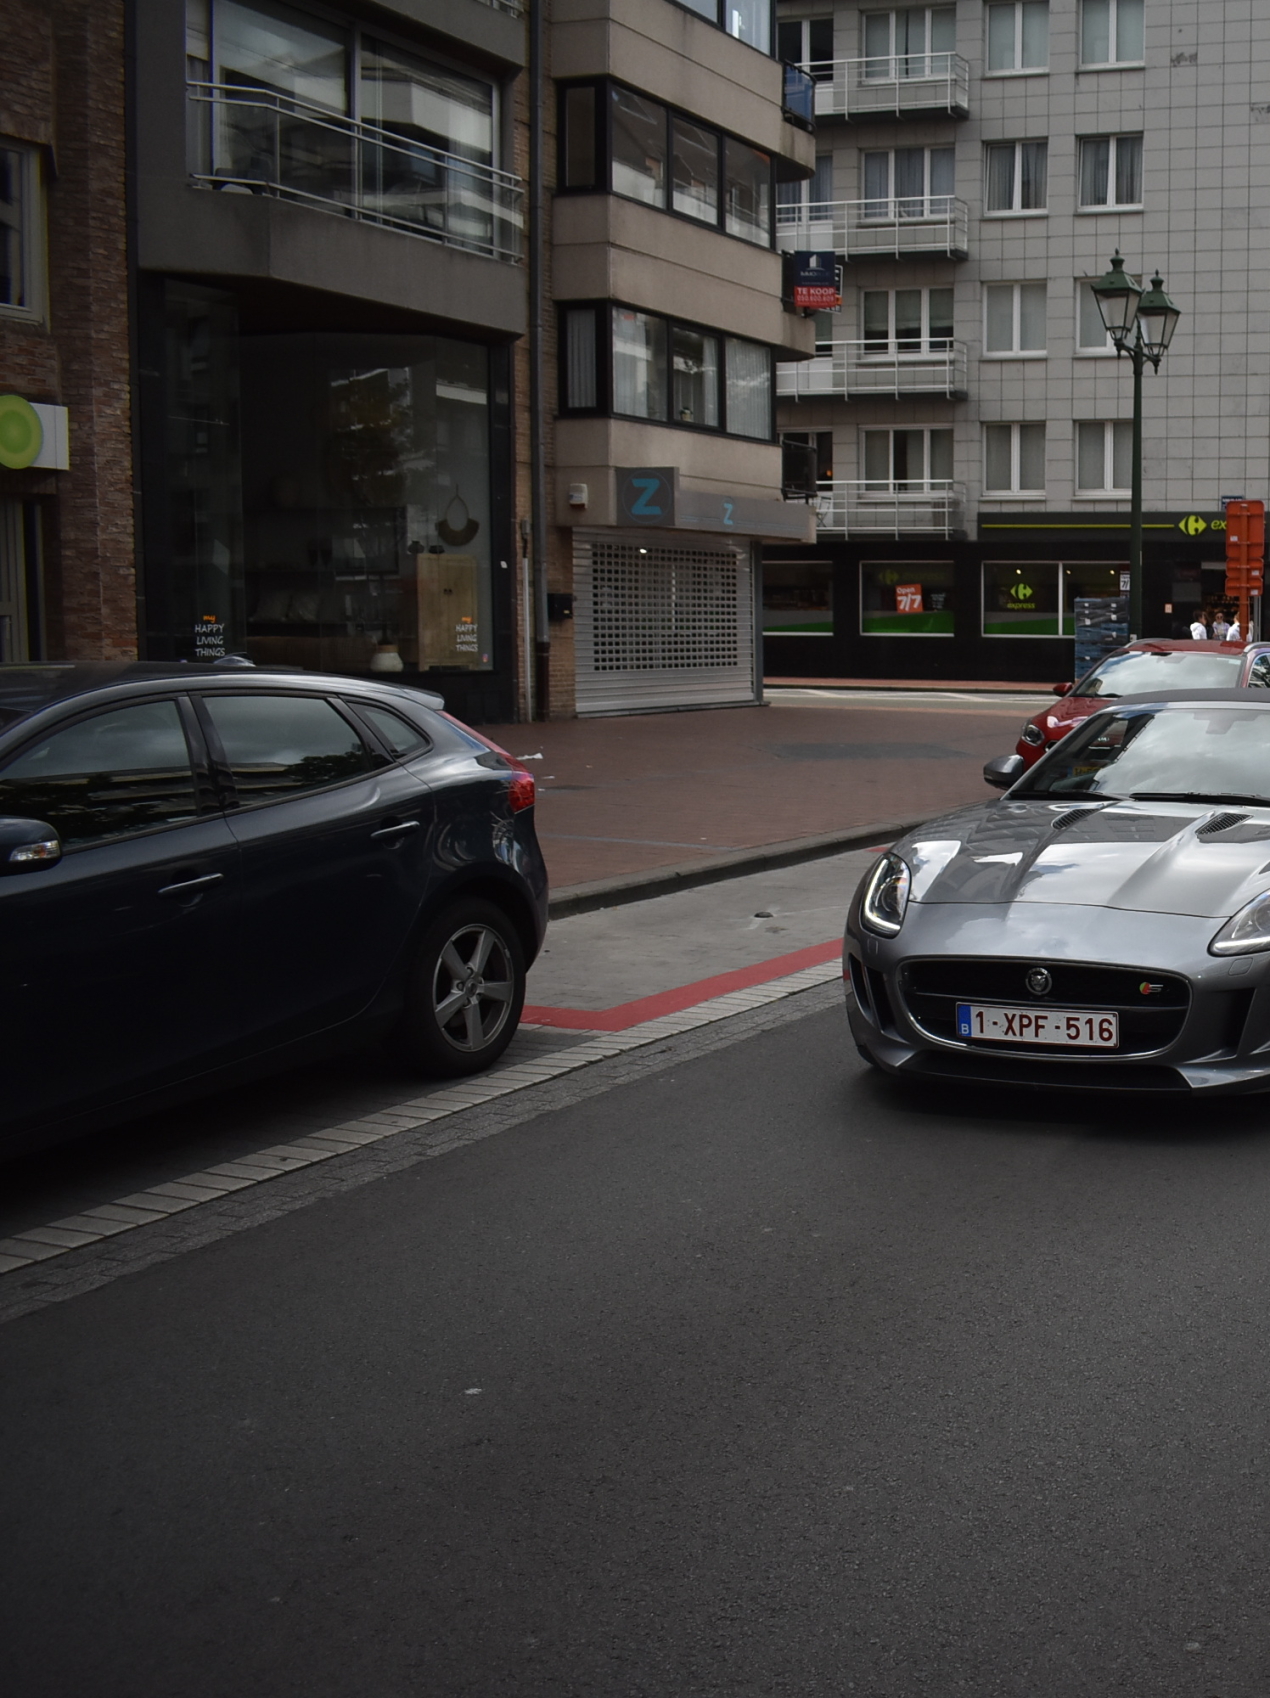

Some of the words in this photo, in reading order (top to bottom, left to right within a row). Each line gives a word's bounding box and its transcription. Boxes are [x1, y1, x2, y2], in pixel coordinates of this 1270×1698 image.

[810, 287, 834, 295] KOOP
[631, 478, 662, 515] Z
[723, 503, 734, 525] Z
[896, 587, 916, 595] Open
[897, 593, 922, 611] 7/7
[1007, 602, 1035, 610] express
[203, 615, 216, 623] my
[194, 623, 225, 633] HAPPY
[455, 623, 478, 632] HAPPY
[196, 636, 224, 645] LIVING
[456, 634, 477, 642] LIVING
[194, 647, 226, 657] THINGS
[455, 644, 479, 652] THINGS
[961, 1023, 969, 1034] B
[975, 1010, 1114, 1042] 1-XPF-516
